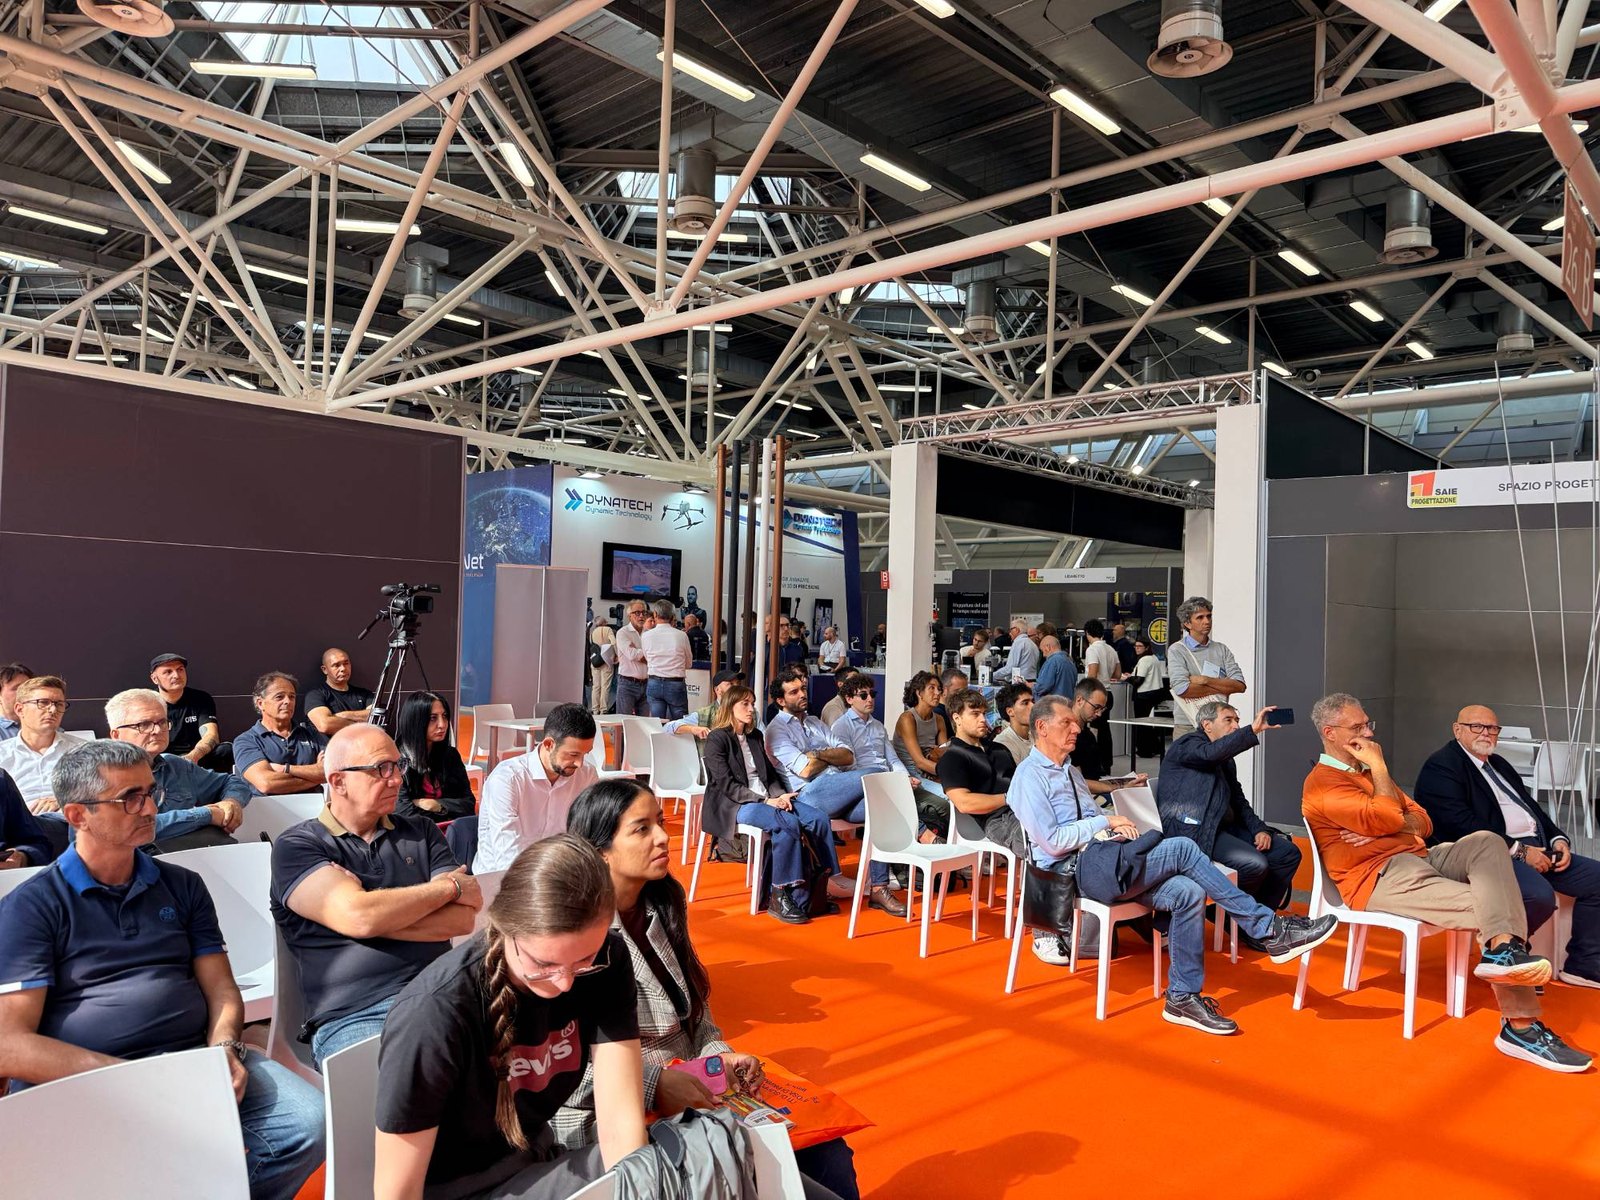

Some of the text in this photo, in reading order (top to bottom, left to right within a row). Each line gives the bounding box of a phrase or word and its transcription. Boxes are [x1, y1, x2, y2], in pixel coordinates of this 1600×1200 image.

[1565, 232, 1579, 295] 26
[1581, 247, 1591, 317] B
[1434, 487, 1458, 496] SAIE
[1498, 482, 1541, 492] SPAZIO
[585, 494, 652, 512] DYNATECH
[1411, 497, 1457, 505] PROGETTAZIONE
[585, 505, 653, 521] Dynamic Technology
[882, 571, 888, 582] B
[508, 1039, 573, 1082] evi's
